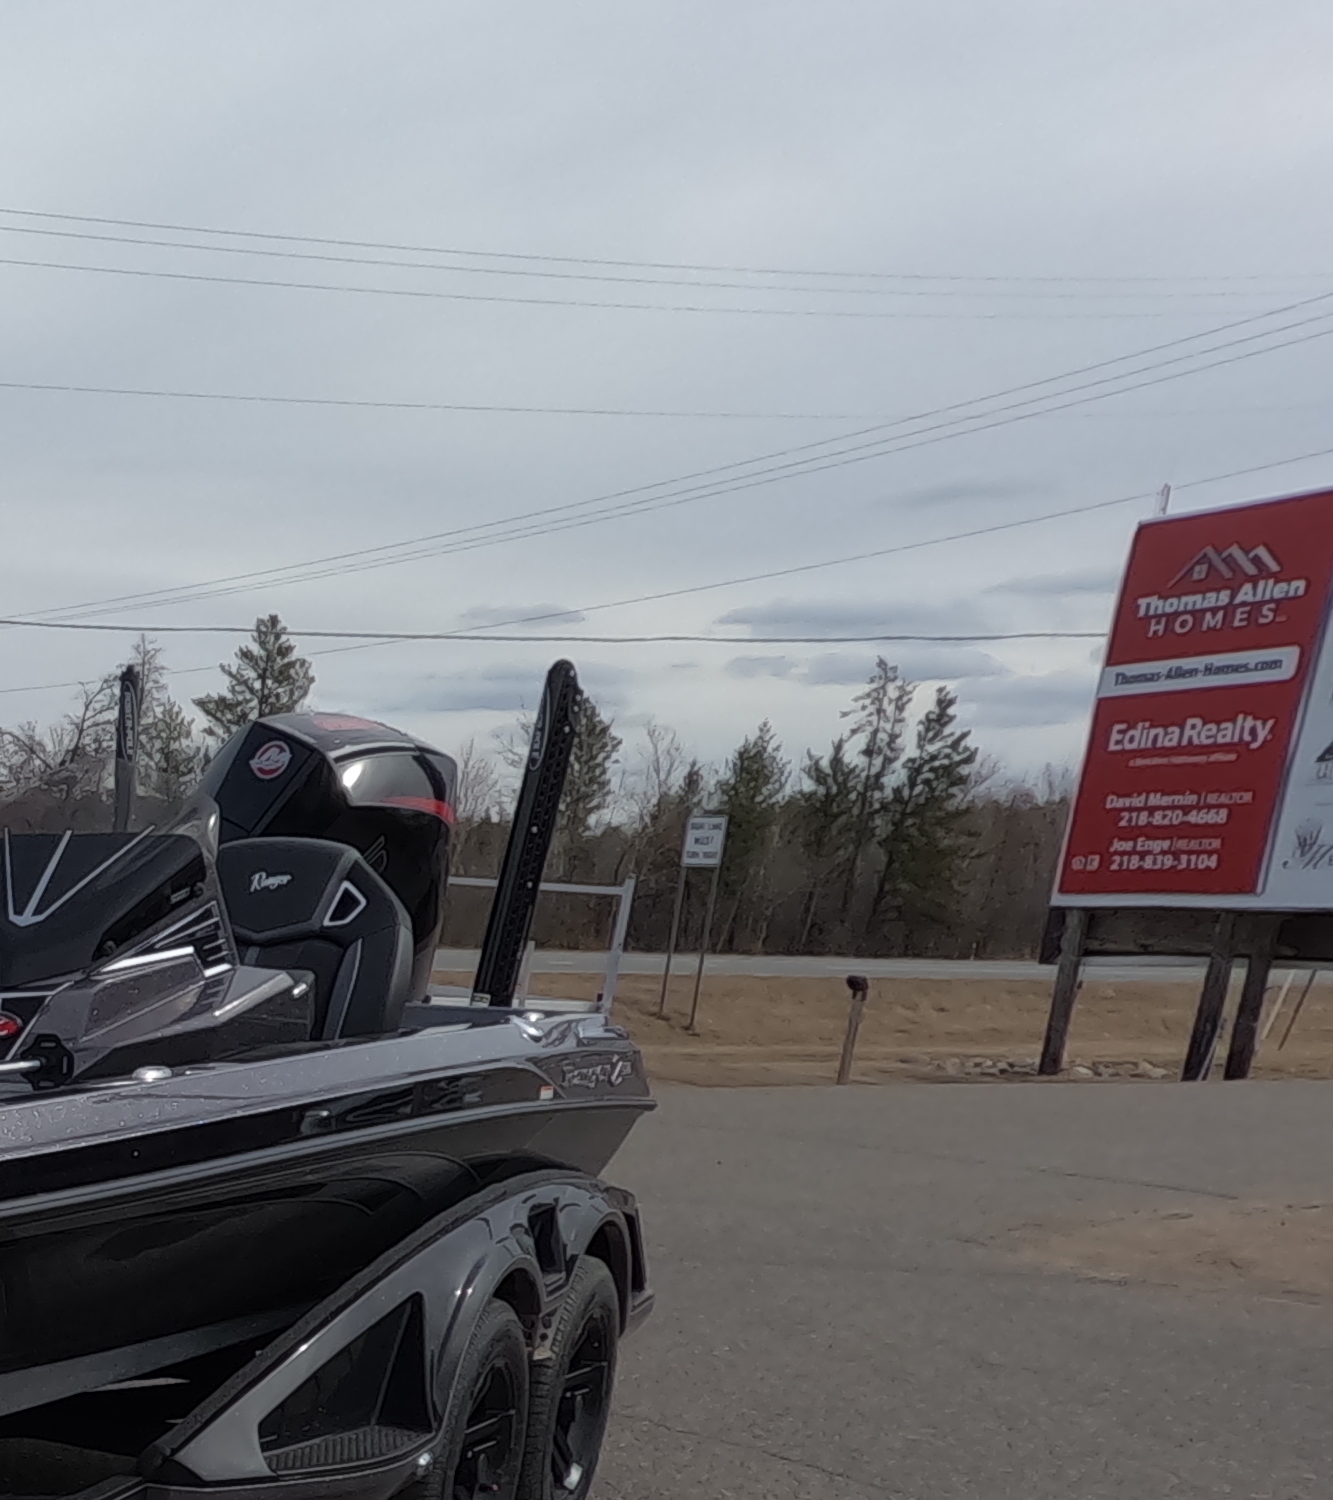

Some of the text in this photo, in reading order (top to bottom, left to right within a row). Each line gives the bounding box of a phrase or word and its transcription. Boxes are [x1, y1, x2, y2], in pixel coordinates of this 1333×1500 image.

[1137, 578, 1307, 618] Thomas Allen
[1147, 603, 1277, 637] HOMES
[1105, 793, 1145, 809] David
[1118, 808, 1228, 827] 218-820-4668
[1109, 838, 1134, 853] Joe
